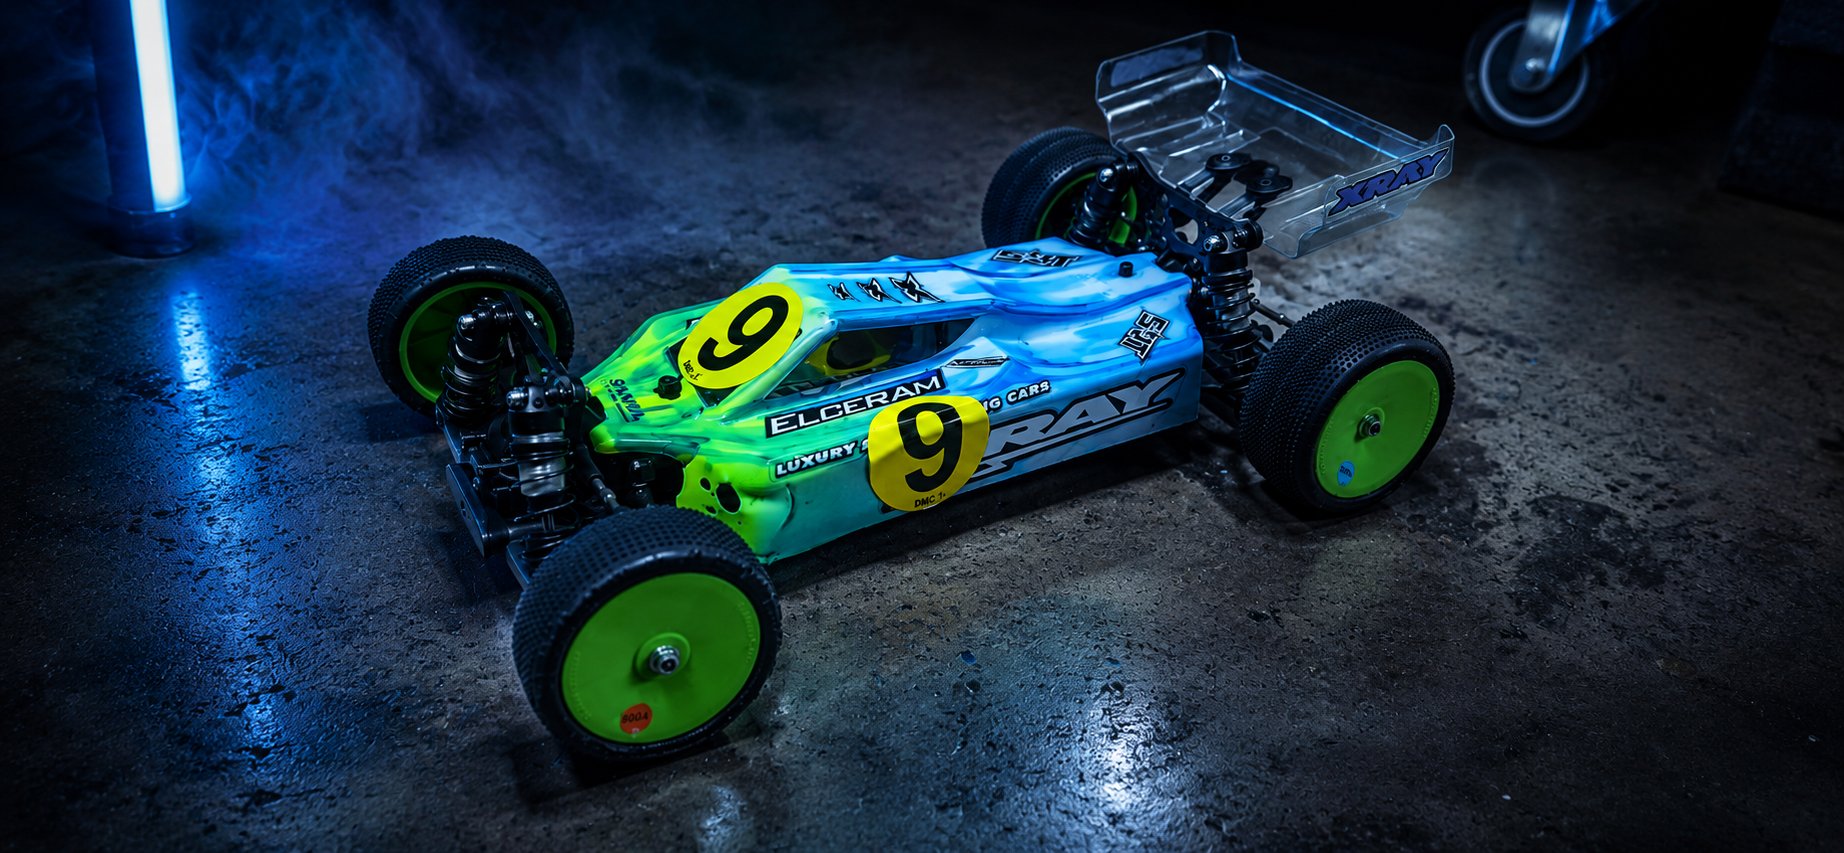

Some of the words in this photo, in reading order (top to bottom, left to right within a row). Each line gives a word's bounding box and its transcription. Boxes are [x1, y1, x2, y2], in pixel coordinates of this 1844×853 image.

[1328, 147, 1449, 216] XRAY
[697, 295, 789, 371] 9
[771, 375, 941, 436] ELCERAM
[1006, 380, 1051, 403] CARS
[775, 442, 856, 477] LUXURY
[896, 402, 964, 493] 9
[914, 495, 936, 508] DMC
